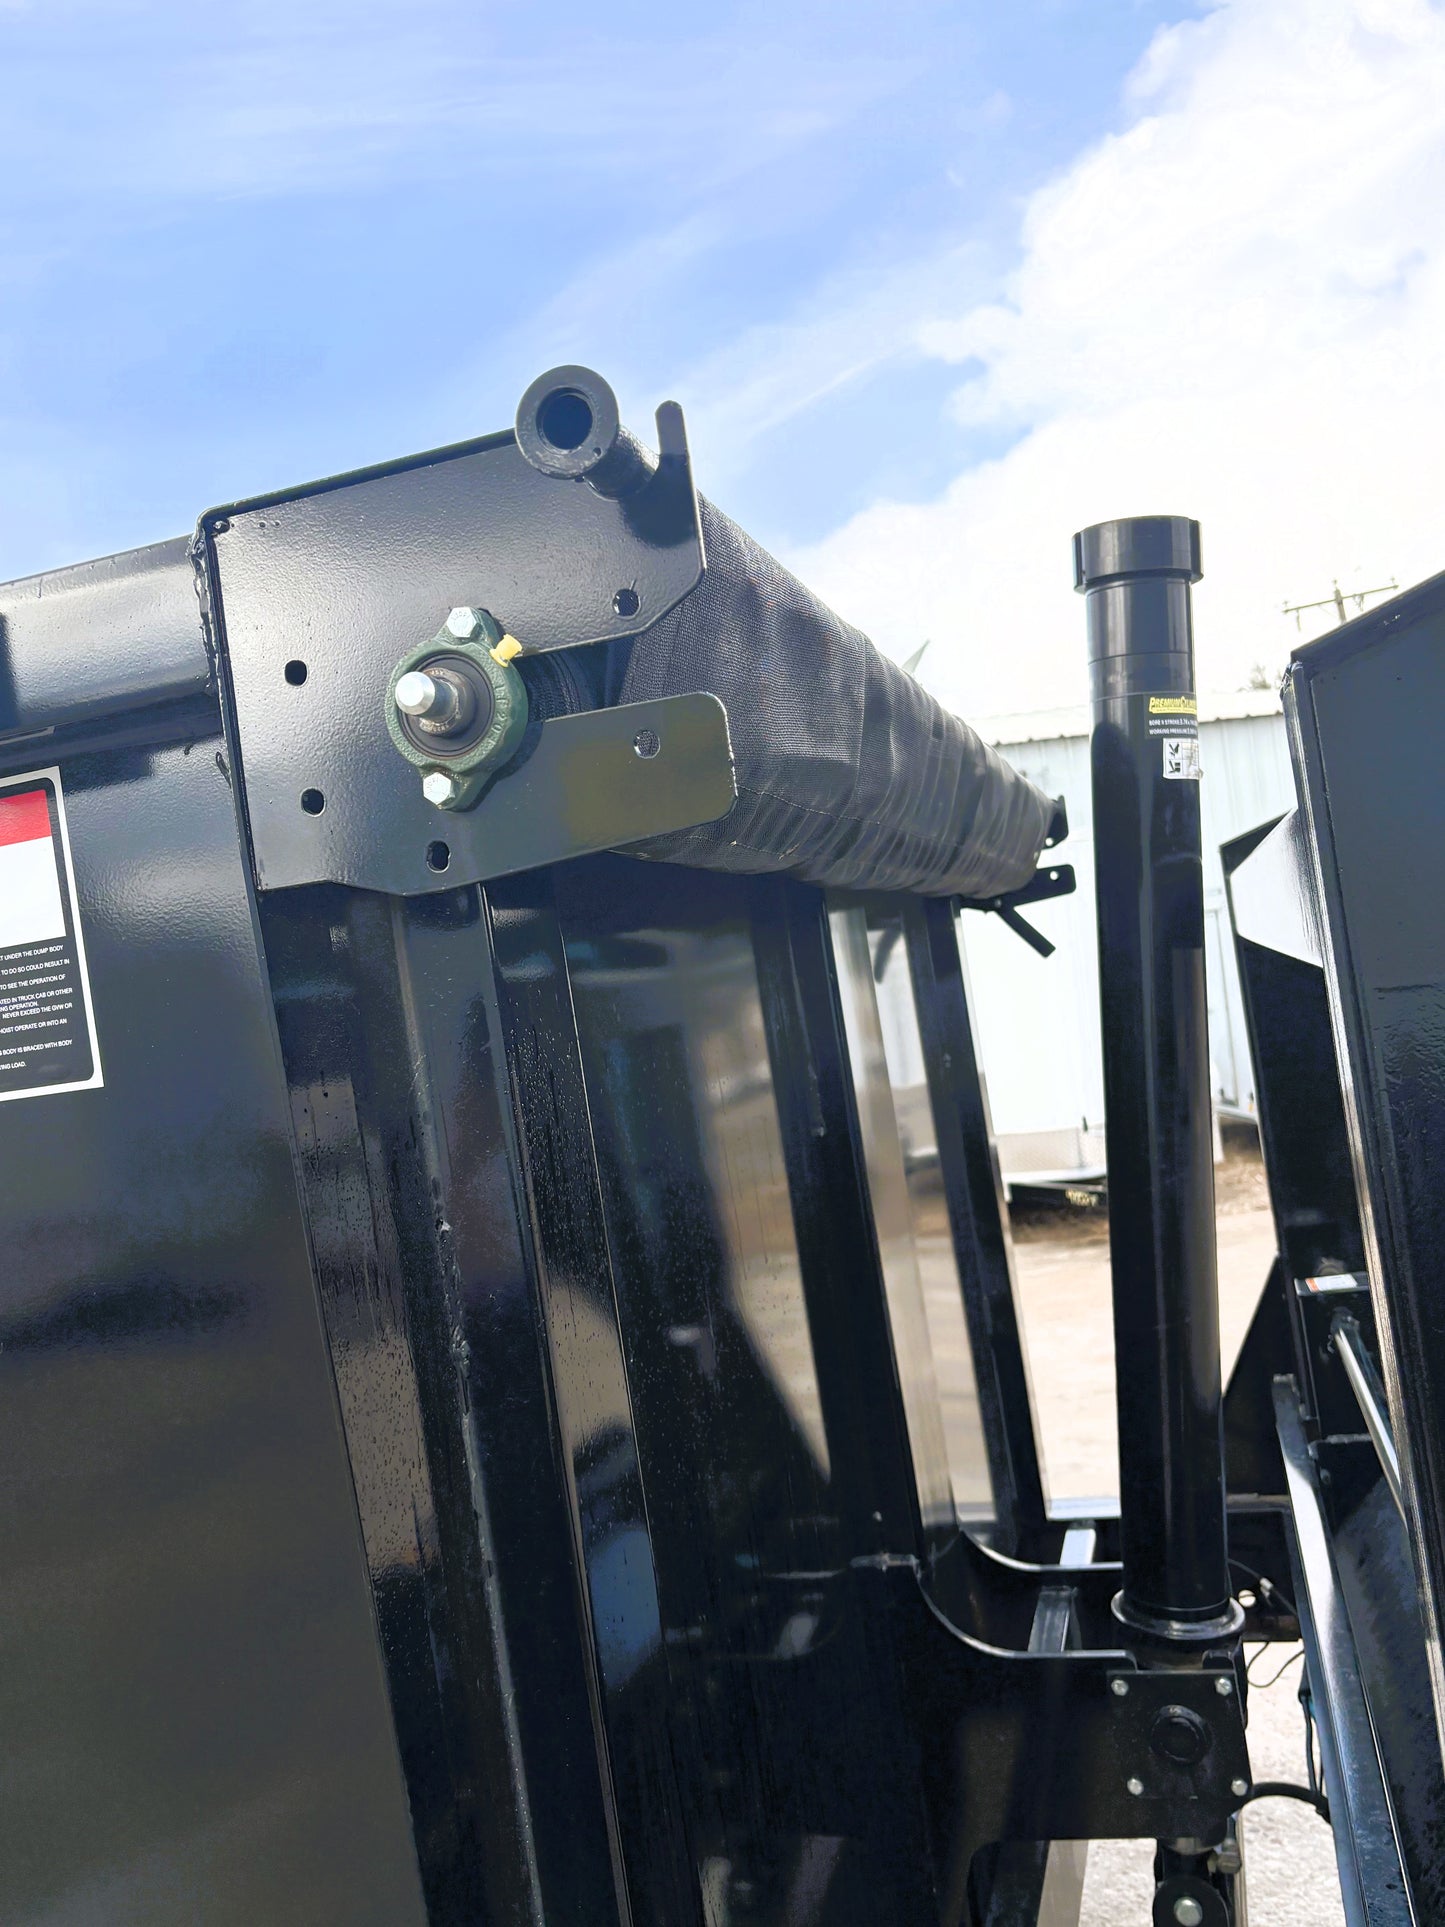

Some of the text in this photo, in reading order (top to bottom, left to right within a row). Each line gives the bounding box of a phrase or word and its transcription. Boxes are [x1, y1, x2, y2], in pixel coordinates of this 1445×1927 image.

[4, 952, 22, 960] UNDER
[33, 947, 48, 955] DUMP
[25, 963, 44, 971] COULD
[44, 959, 63, 968] RESULT
[29, 975, 58, 985] OPERATION
[55, 987, 73, 996] OTHER
[2, 1011, 19, 1019] NEVER
[20, 1008, 41, 1016] EXCEED
[0, 1026, 14, 1034] HOIST
[14, 1022, 38, 1032] OPERATE
[23, 1043, 44, 1052] BRACED
[44, 1041, 58, 1049] WITH
